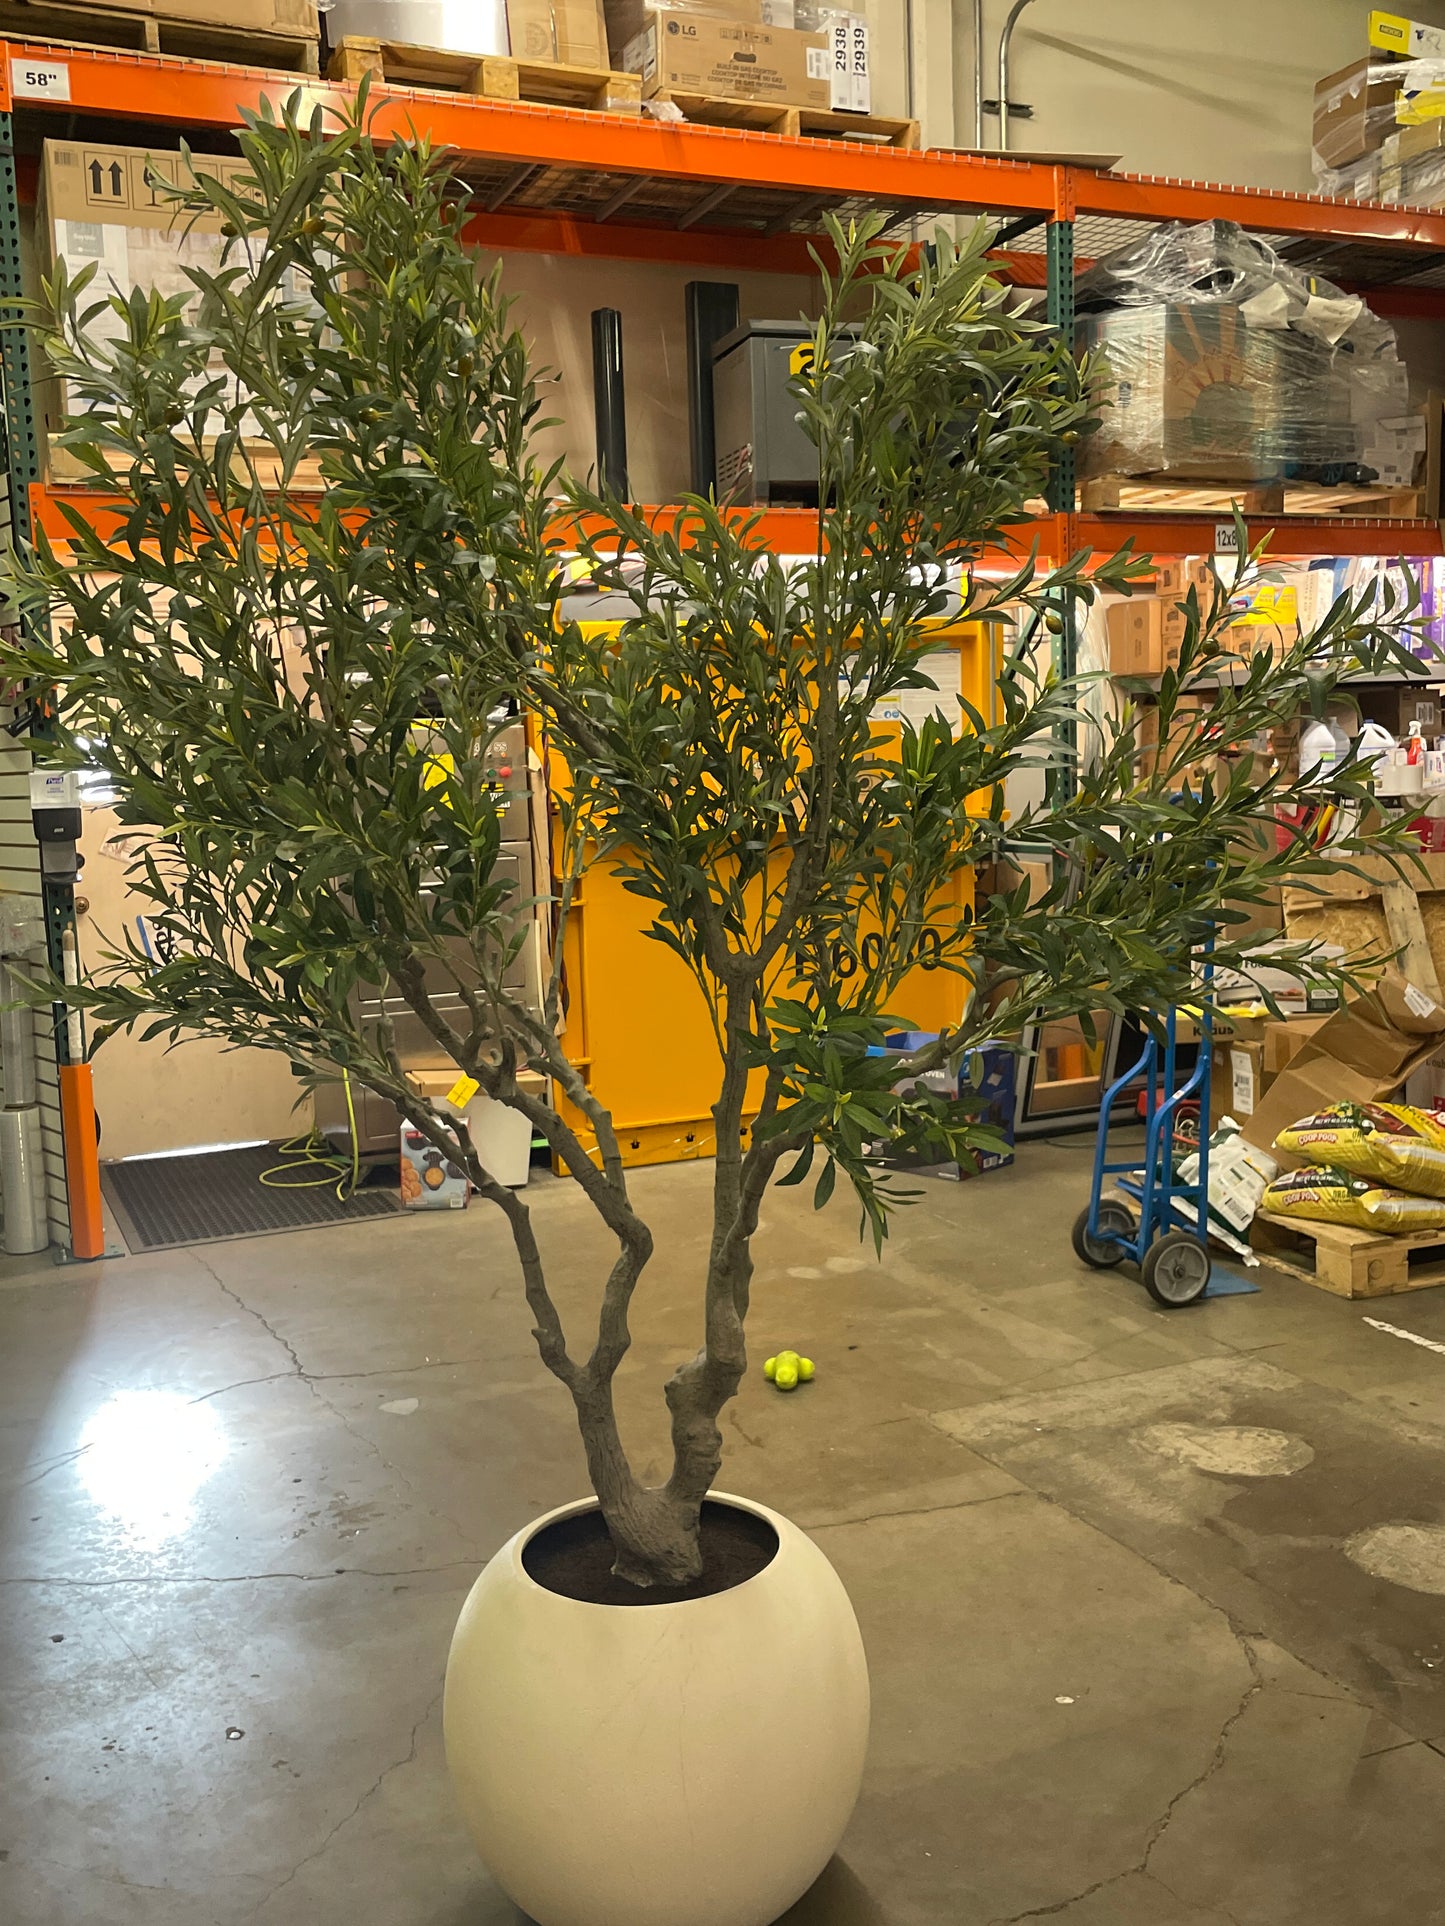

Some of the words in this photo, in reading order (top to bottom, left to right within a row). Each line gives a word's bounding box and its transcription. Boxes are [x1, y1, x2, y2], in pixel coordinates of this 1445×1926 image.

[682, 25, 697, 36] LG
[835, 27, 847, 71] 2938
[853, 28, 866, 72] 2939
[26, 71, 56, 87] 58"
[796, 928, 941, 981] 600
[1193, 1026, 1234, 1037] Kaus
